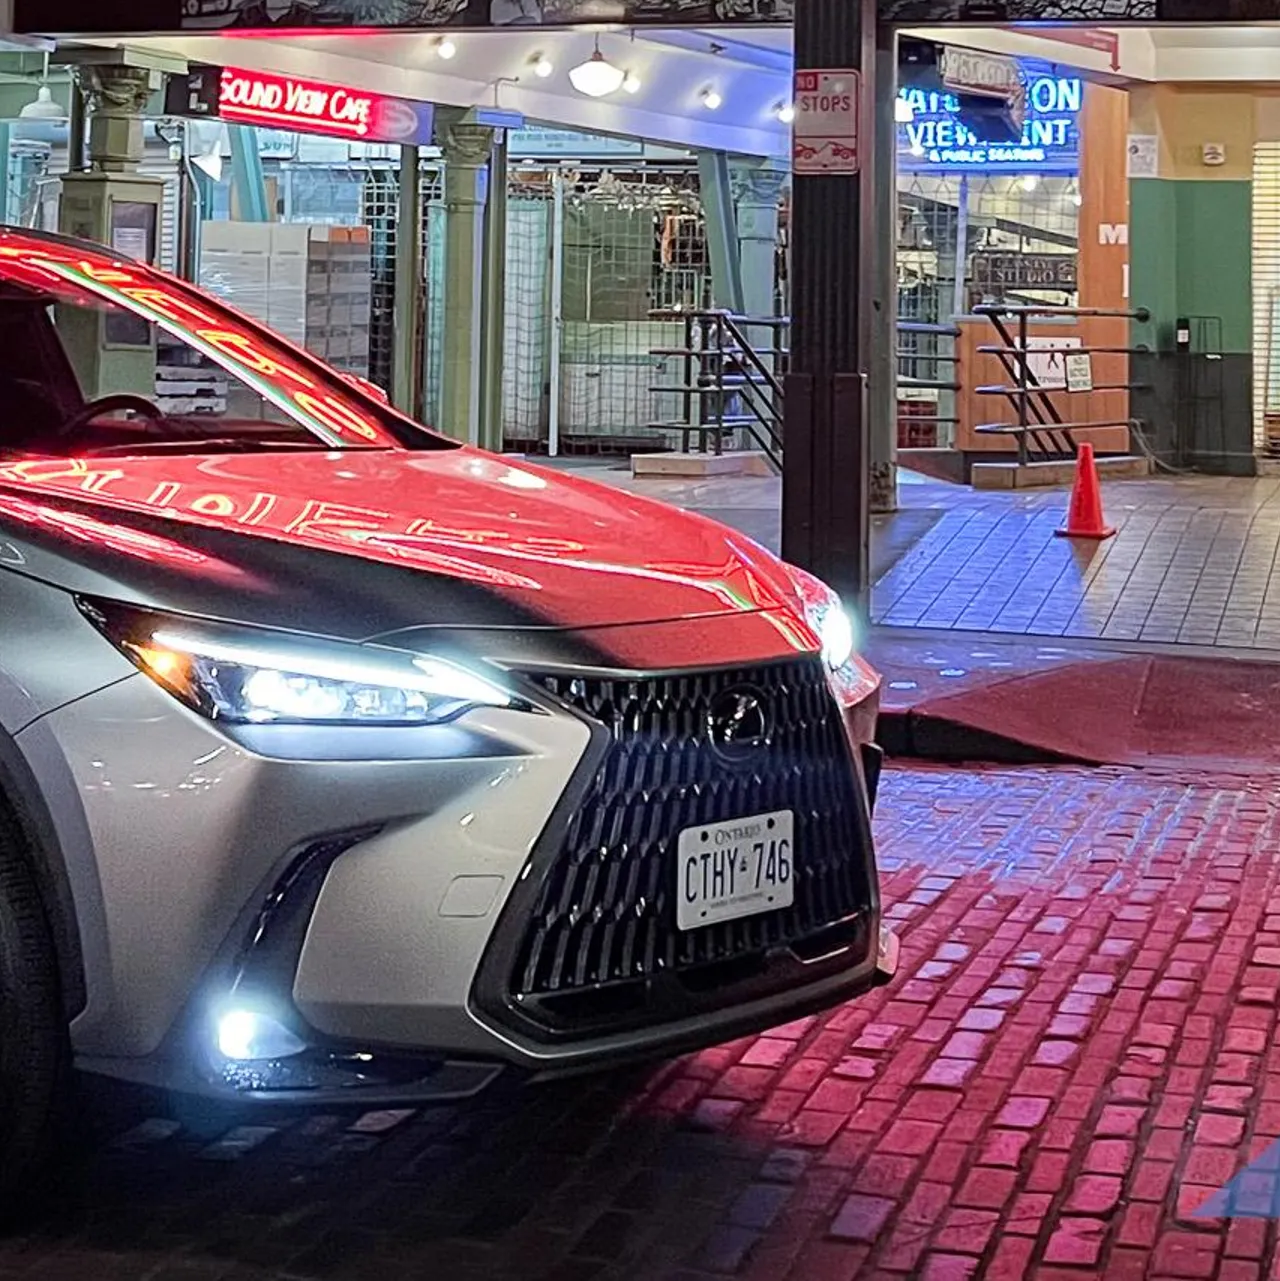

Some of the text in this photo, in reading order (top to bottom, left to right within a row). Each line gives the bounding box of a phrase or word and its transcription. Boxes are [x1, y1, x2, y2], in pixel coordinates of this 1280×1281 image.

[219, 72, 370, 121] SOUND VIEW CAFE
[801, 96, 851, 112] STOPS
[997, 269, 1054, 282] STUDIO
[685, 839, 790, 903] CTHY 746
